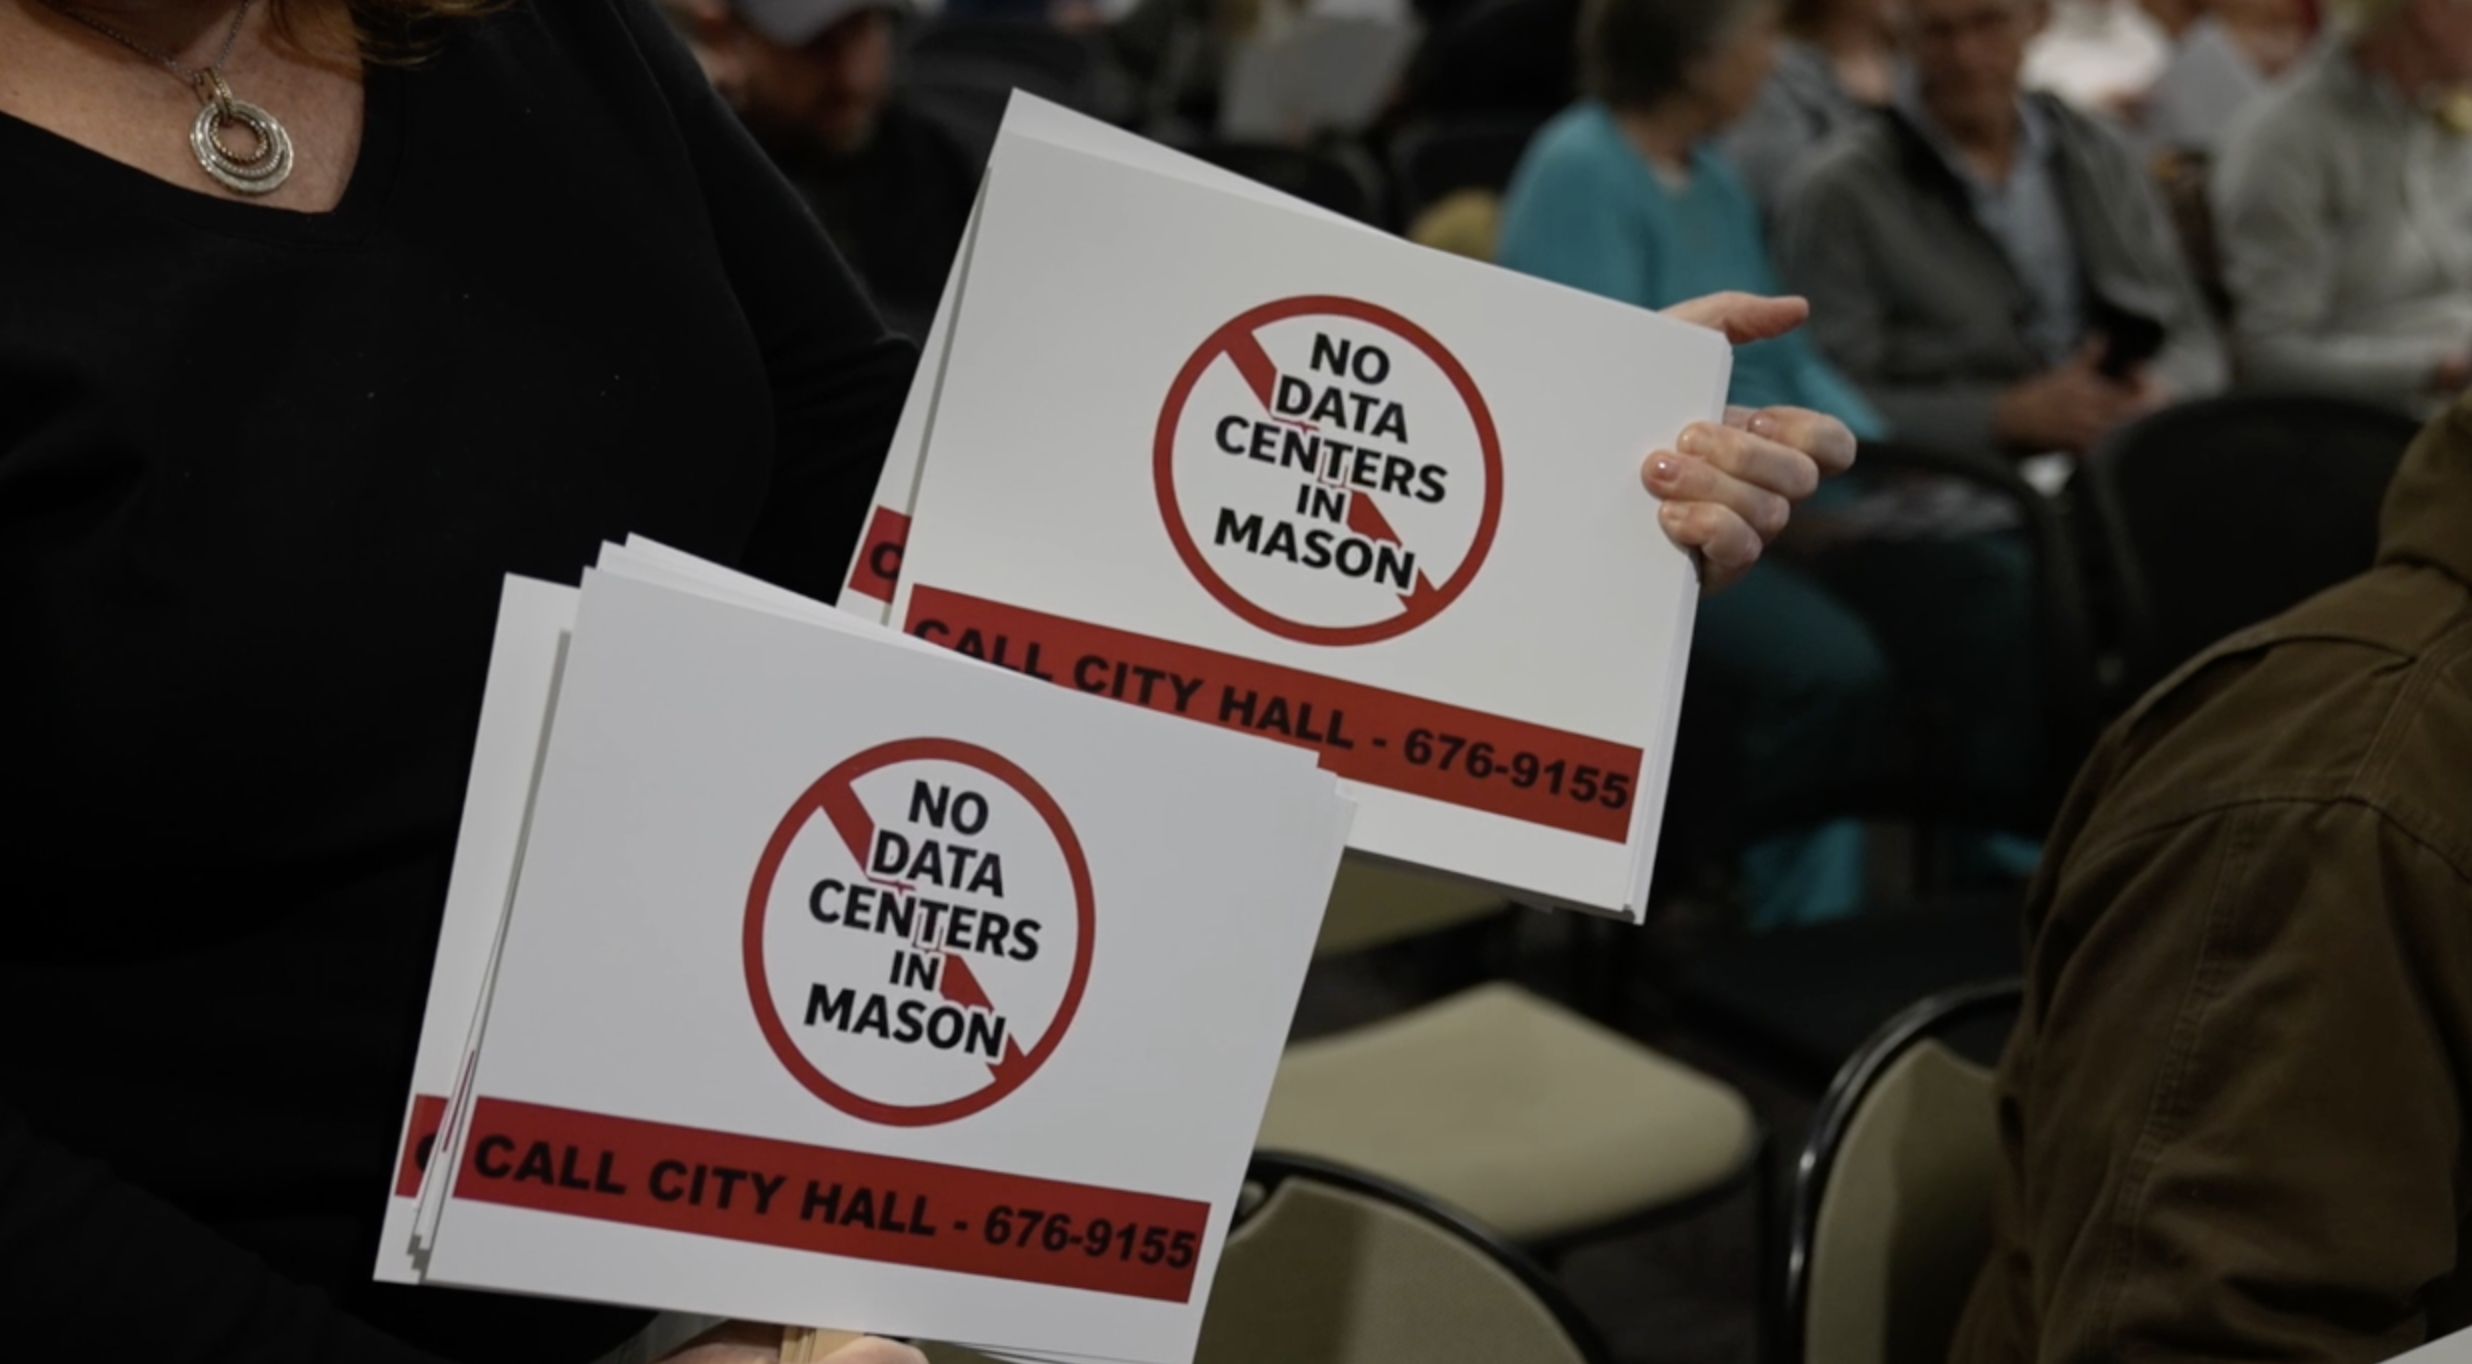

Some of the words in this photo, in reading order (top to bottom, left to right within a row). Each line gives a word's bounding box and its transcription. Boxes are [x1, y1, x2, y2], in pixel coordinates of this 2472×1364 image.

[1309, 332, 1391, 385] NO
[1275, 375, 1408, 443] DATA
[1215, 415, 1448, 504] CENTERS
[1297, 484, 1345, 523] IN
[1214, 507, 1415, 589] MASON
[1073, 655, 1204, 713] CITY
[1218, 685, 1355, 750] HALL
[1403, 728, 1631, 810] 676-9155
[908, 779, 989, 835] NO
[872, 829, 1004, 898] DATA
[809, 878, 1042, 961] CENTERS
[889, 950, 939, 991] IN
[803, 983, 1006, 1058] MASON
[473, 1134, 628, 1196] CALL
[647, 1159, 787, 1215] CITY
[799, 1179, 938, 1238] HALL
[983, 1205, 1197, 1269] 676-9155
